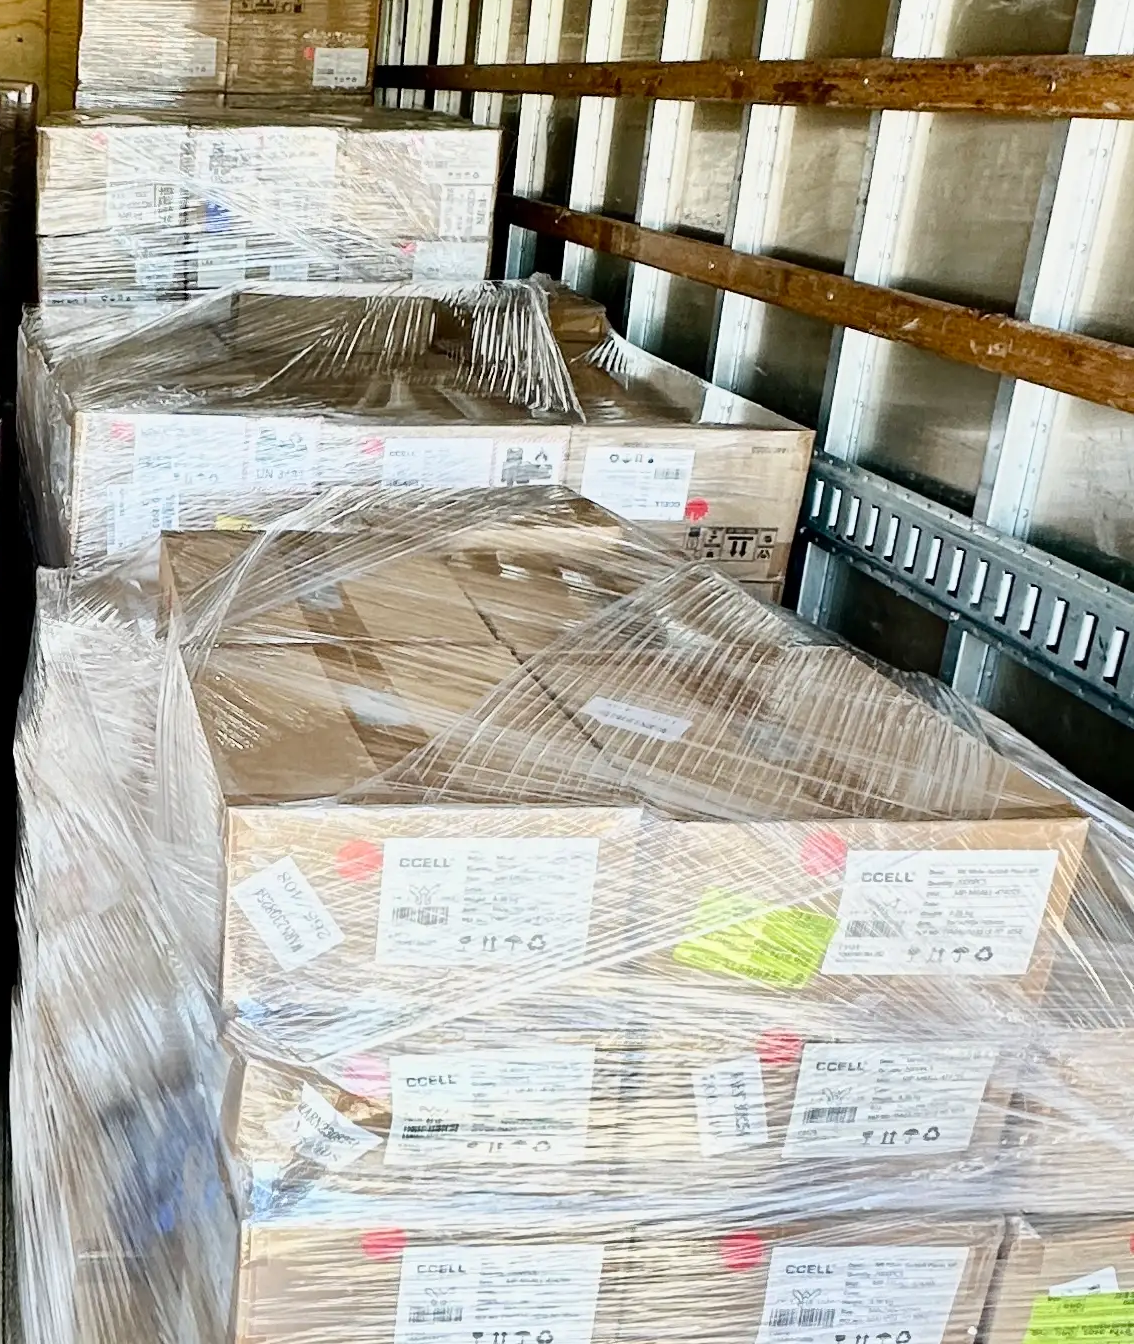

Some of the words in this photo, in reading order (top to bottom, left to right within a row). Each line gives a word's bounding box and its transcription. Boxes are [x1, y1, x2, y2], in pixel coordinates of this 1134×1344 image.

[399, 857, 451, 868] CCELL
[861, 872, 914, 883] CCELL
[816, 1061, 865, 1072] CCELL
[417, 1264, 467, 1274] CCELL
[785, 1264, 834, 1275] CCELL
